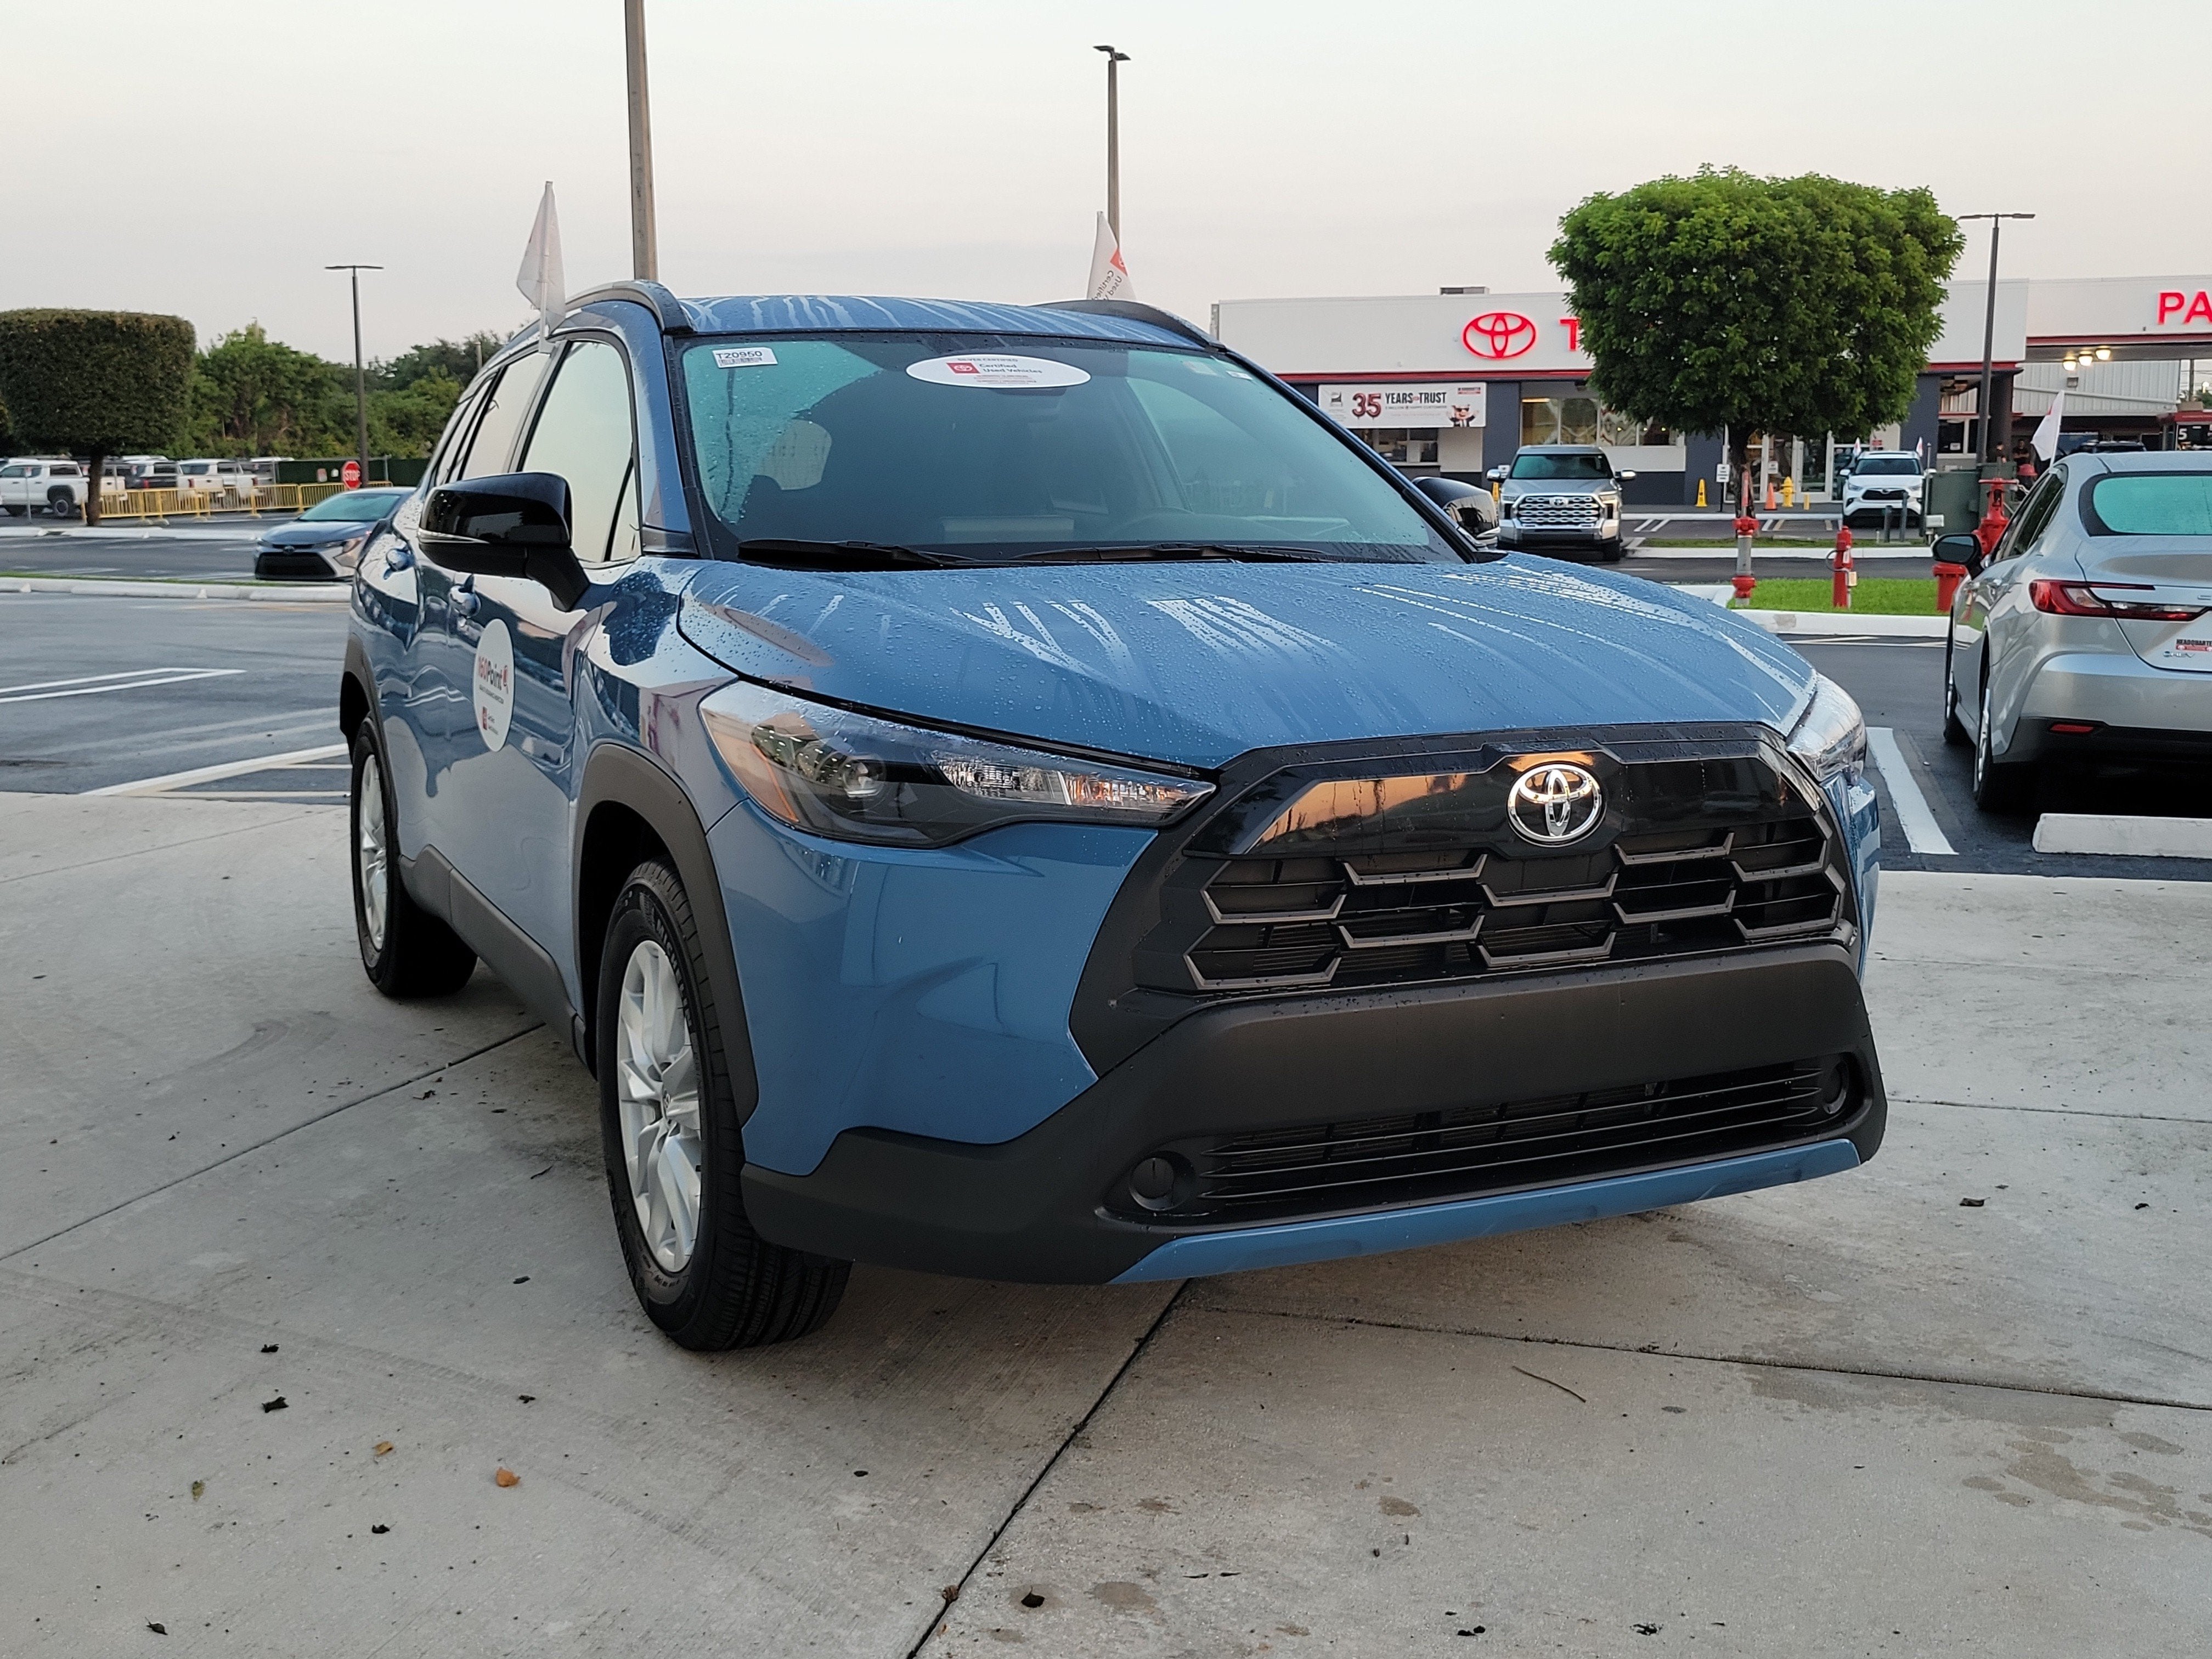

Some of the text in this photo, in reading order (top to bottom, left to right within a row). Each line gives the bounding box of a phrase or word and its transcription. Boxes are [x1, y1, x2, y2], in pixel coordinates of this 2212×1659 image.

[2159, 291, 2212, 324] PA
[715, 351, 763, 359] T20950
[1352, 393, 1381, 417] 35
[1385, 393, 1413, 404] YEARS
[1419, 392, 1447, 403] TRUST
[2178, 428, 2187, 440] 5
[345, 470, 360, 481] STOP
[656, 918, 692, 1027] MICHELIN
